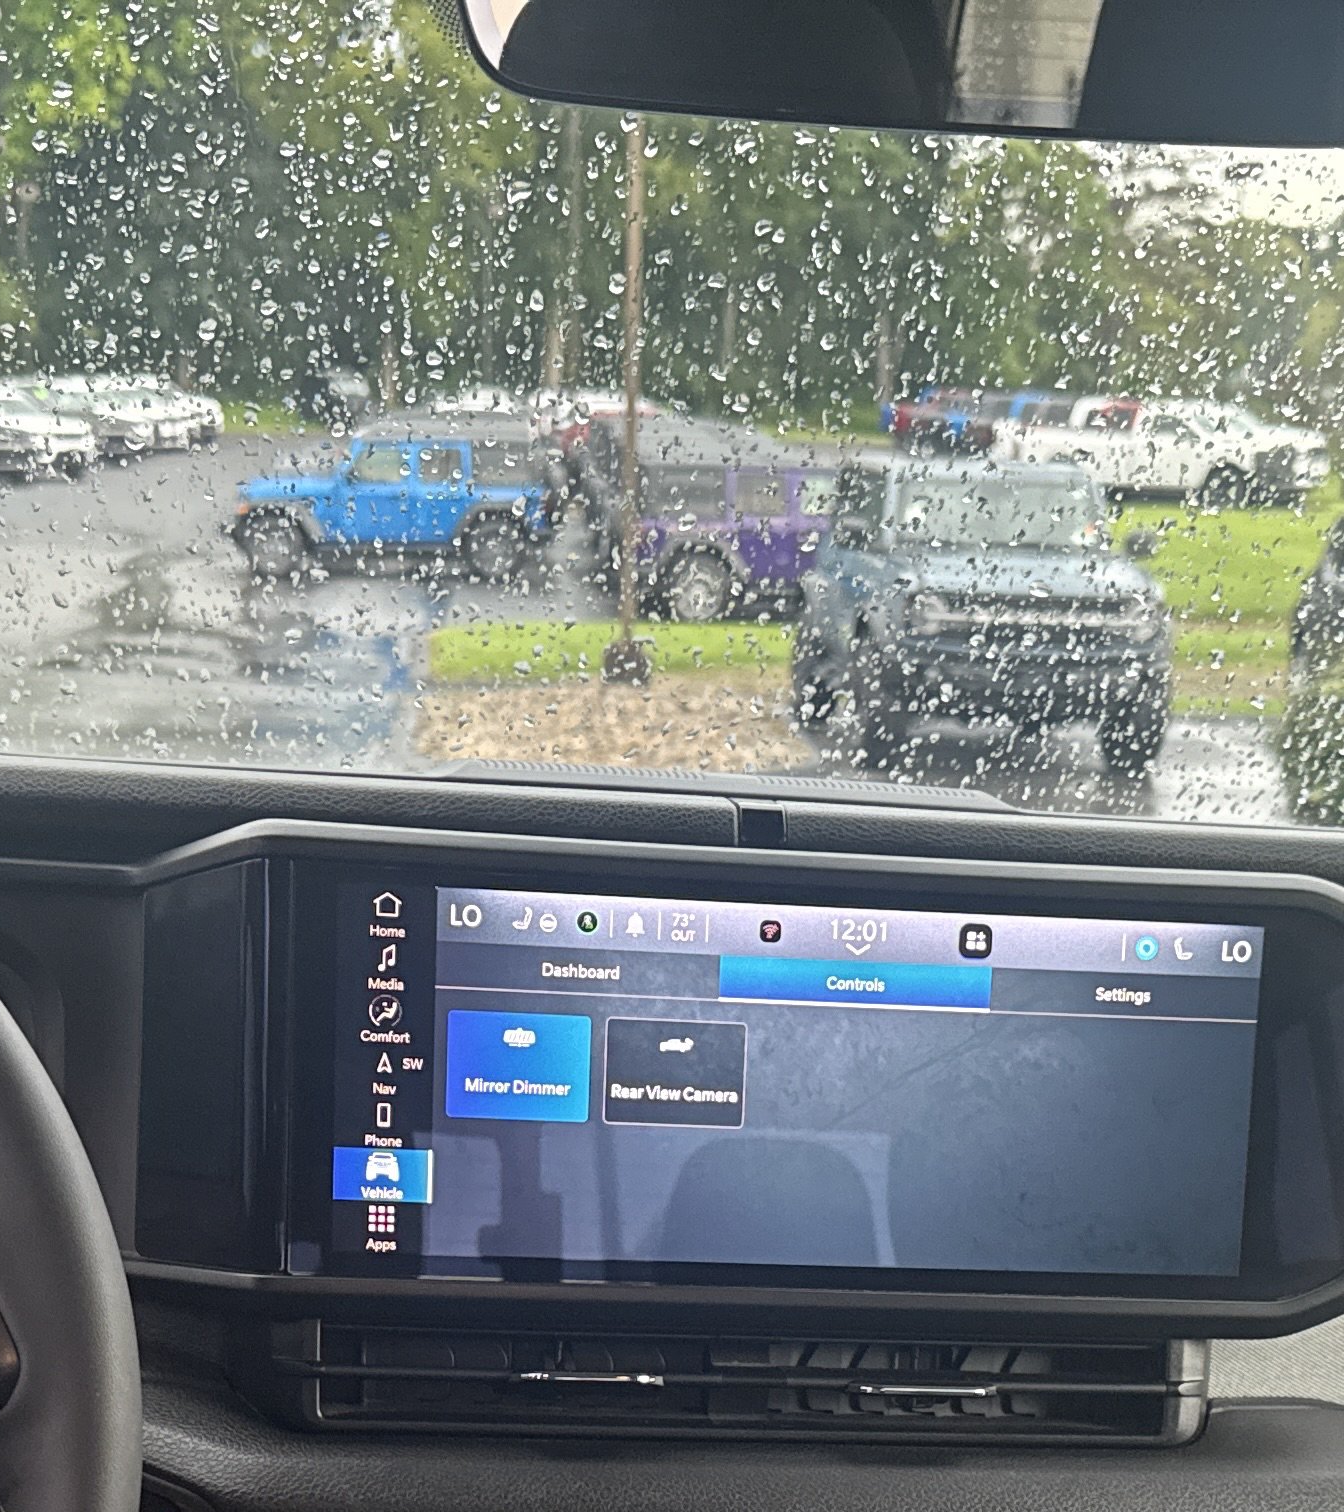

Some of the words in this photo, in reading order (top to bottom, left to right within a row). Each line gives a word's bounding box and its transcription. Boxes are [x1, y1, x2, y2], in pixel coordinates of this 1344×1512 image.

[450, 903, 482, 928] LO
[369, 924, 406, 939] Home
[671, 929, 696, 943] OUT
[830, 919, 888, 942] 12:01
[1221, 940, 1253, 963] LO
[542, 962, 621, 981] Dashboard
[368, 977, 405, 991] Media
[826, 976, 885, 993] Controls
[1095, 987, 1151, 1006] Settings
[360, 1029, 411, 1044] Comfort
[402, 1057, 423, 1071] SW
[372, 1082, 397, 1095] Nav
[465, 1078, 510, 1094] Mirror
[512, 1080, 571, 1097] Dimmer
[611, 1084, 644, 1099] Rear
[646, 1085, 680, 1101] View
[682, 1087, 738, 1104] Camera
[364, 1134, 402, 1149] Phone
[361, 1185, 404, 1200] Vehicle
[365, 1238, 397, 1252] Apps
